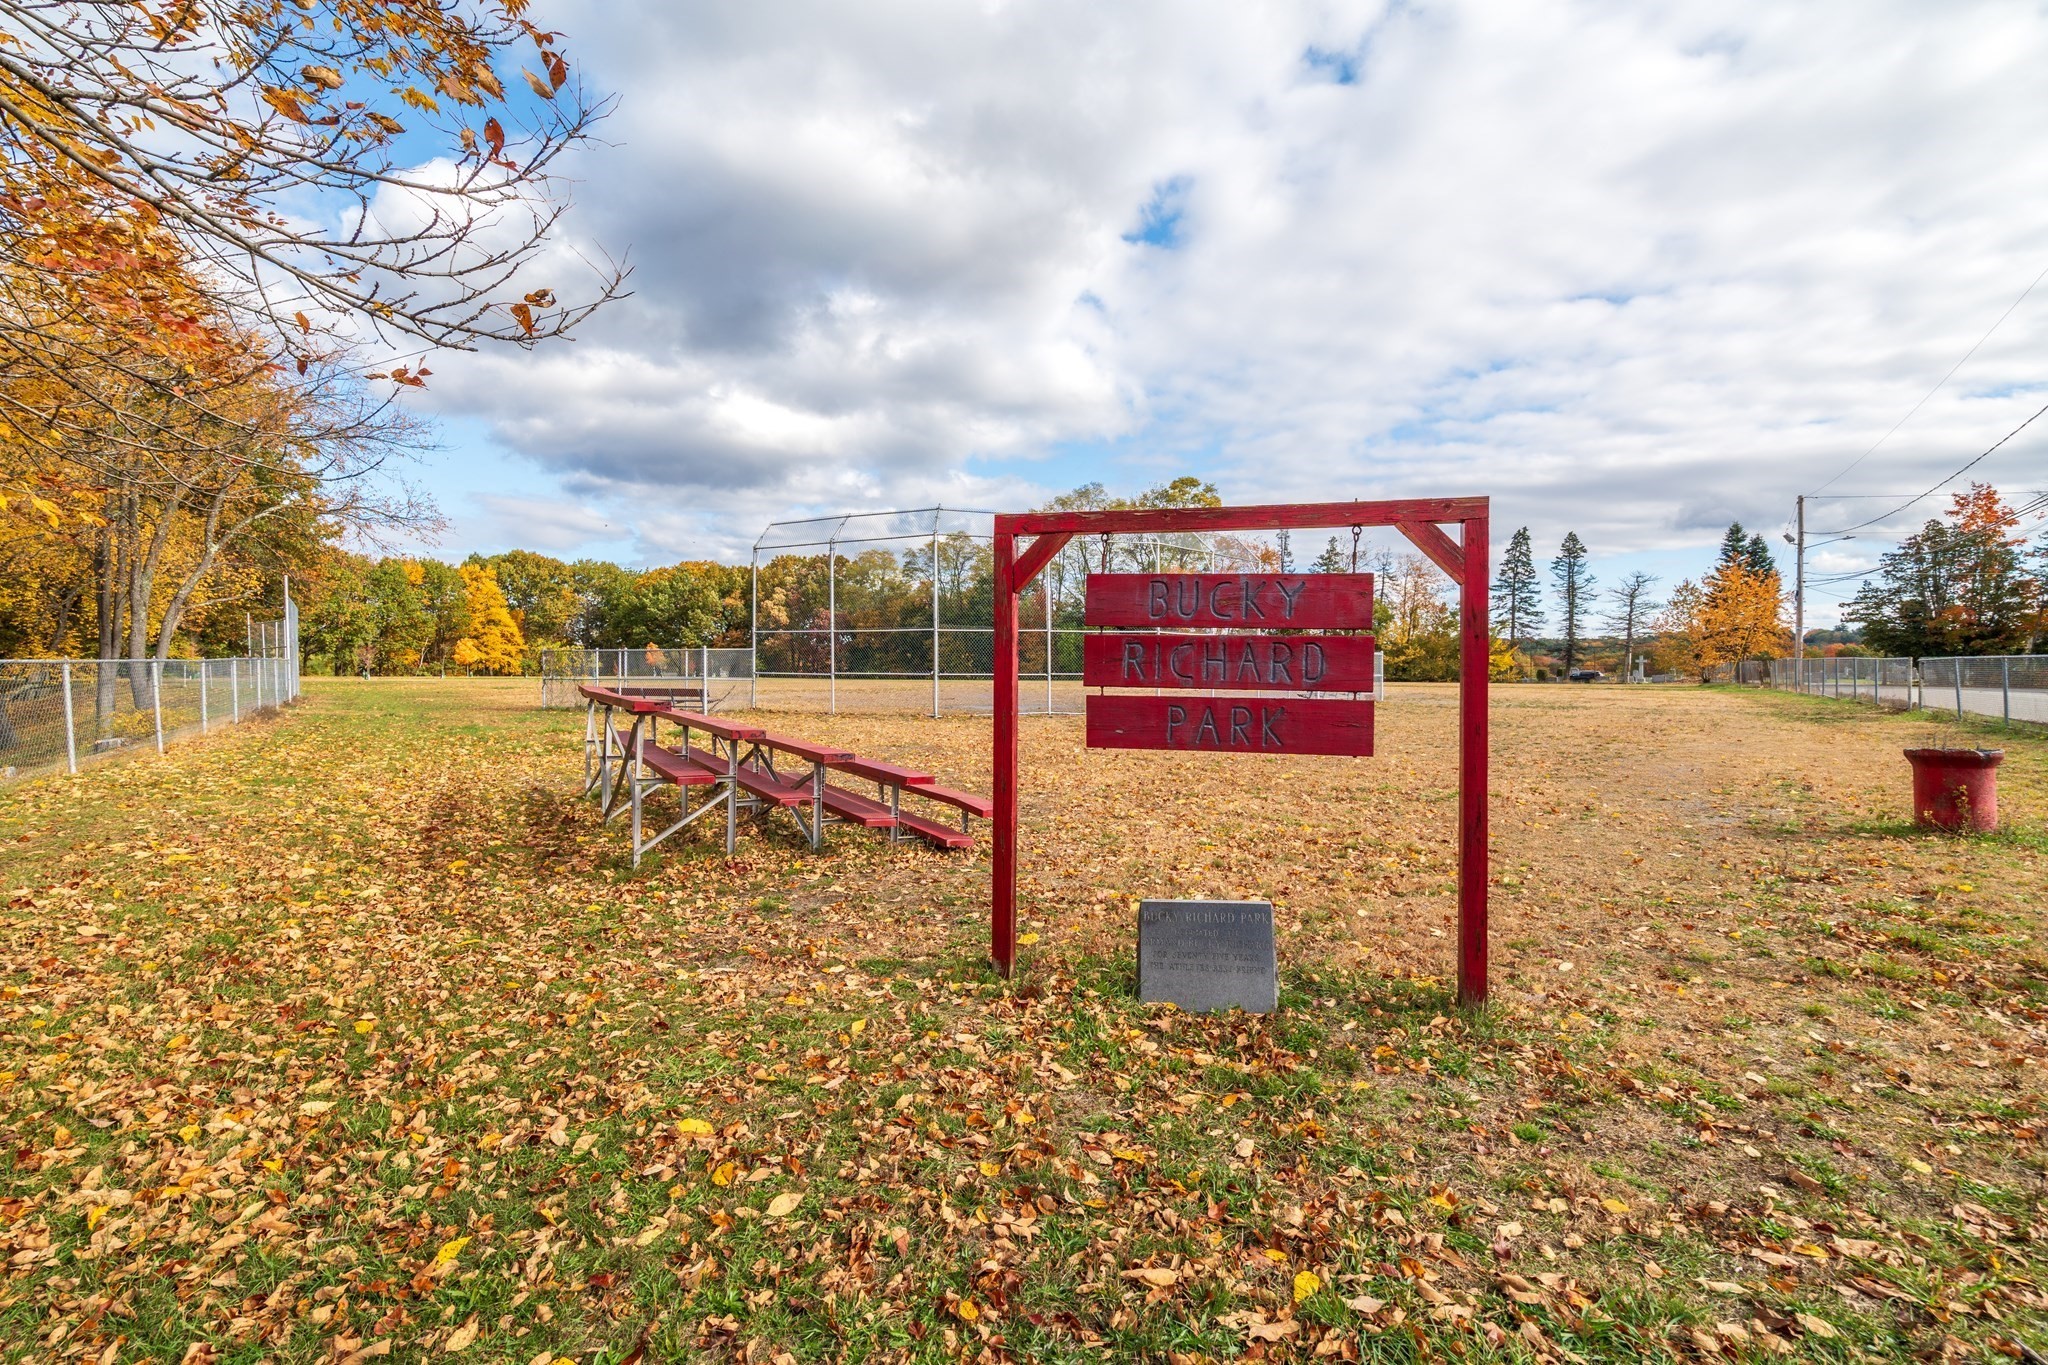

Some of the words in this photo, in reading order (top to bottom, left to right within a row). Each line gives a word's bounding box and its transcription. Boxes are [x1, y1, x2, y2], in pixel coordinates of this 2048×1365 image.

[1149, 580, 1306, 620] BUCKY
[1123, 640, 1326, 683] RICHARD
[1167, 704, 1285, 747] PARK
[1143, 910, 1179, 922] BUCKY
[1186, 911, 1235, 923] RICHARD
[1240, 912, 1269, 924] PARK
